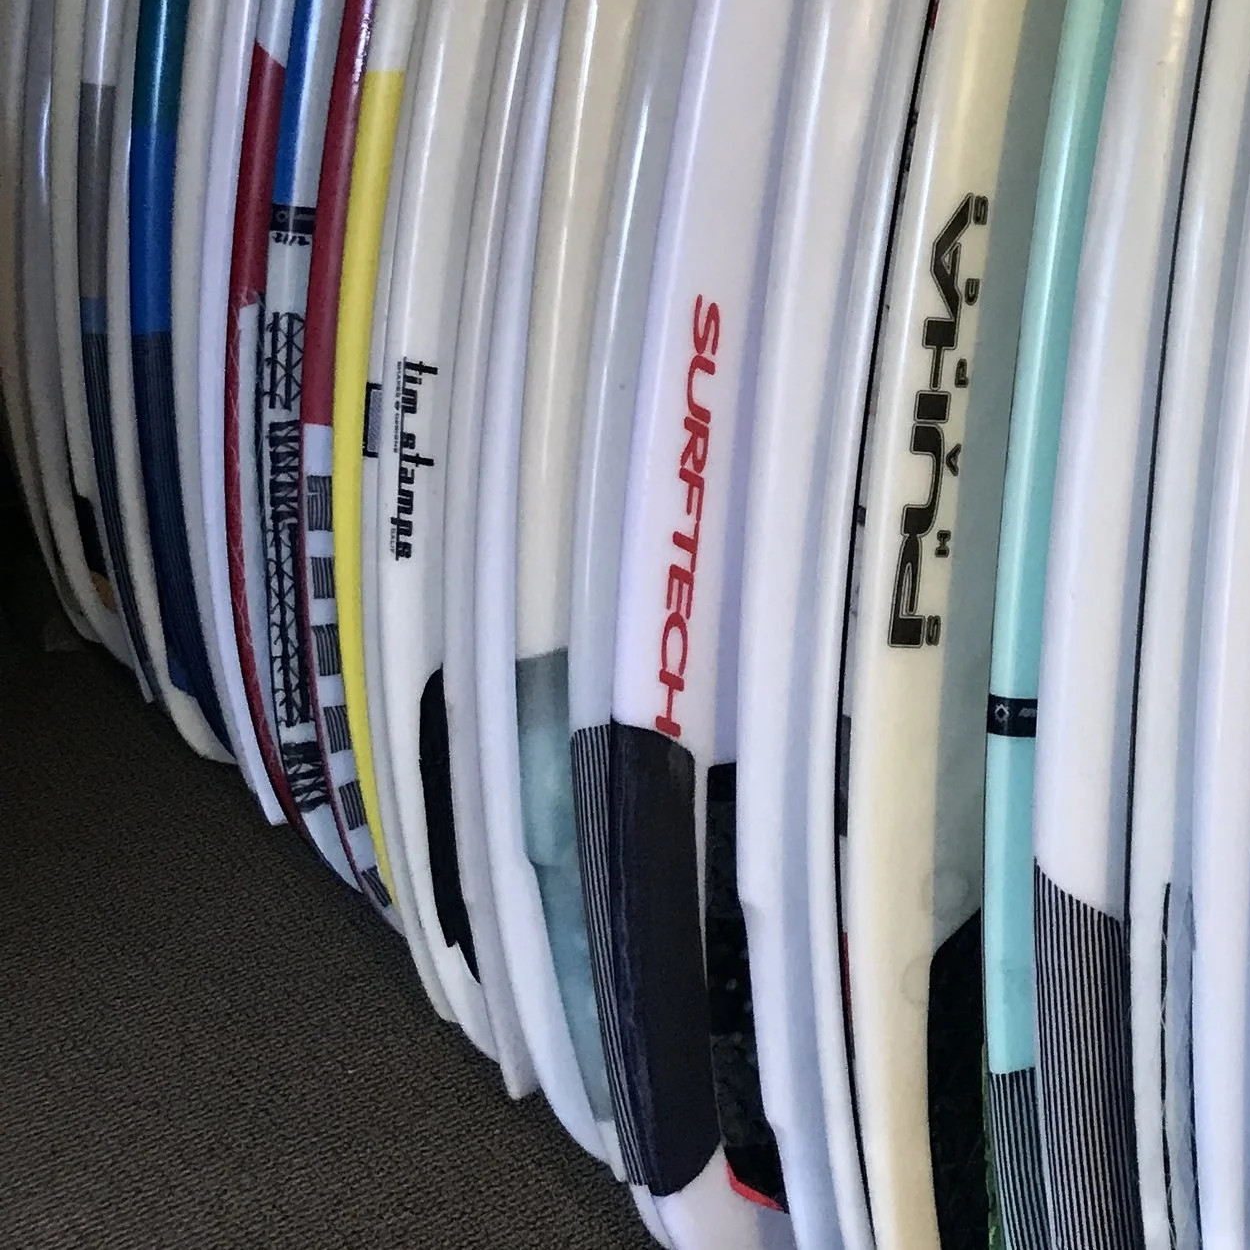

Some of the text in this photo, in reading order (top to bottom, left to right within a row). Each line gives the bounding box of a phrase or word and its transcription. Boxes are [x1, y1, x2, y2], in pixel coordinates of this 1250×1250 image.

[391, 360, 438, 559] tim stamps
[656, 294, 720, 738] SURFTECH
